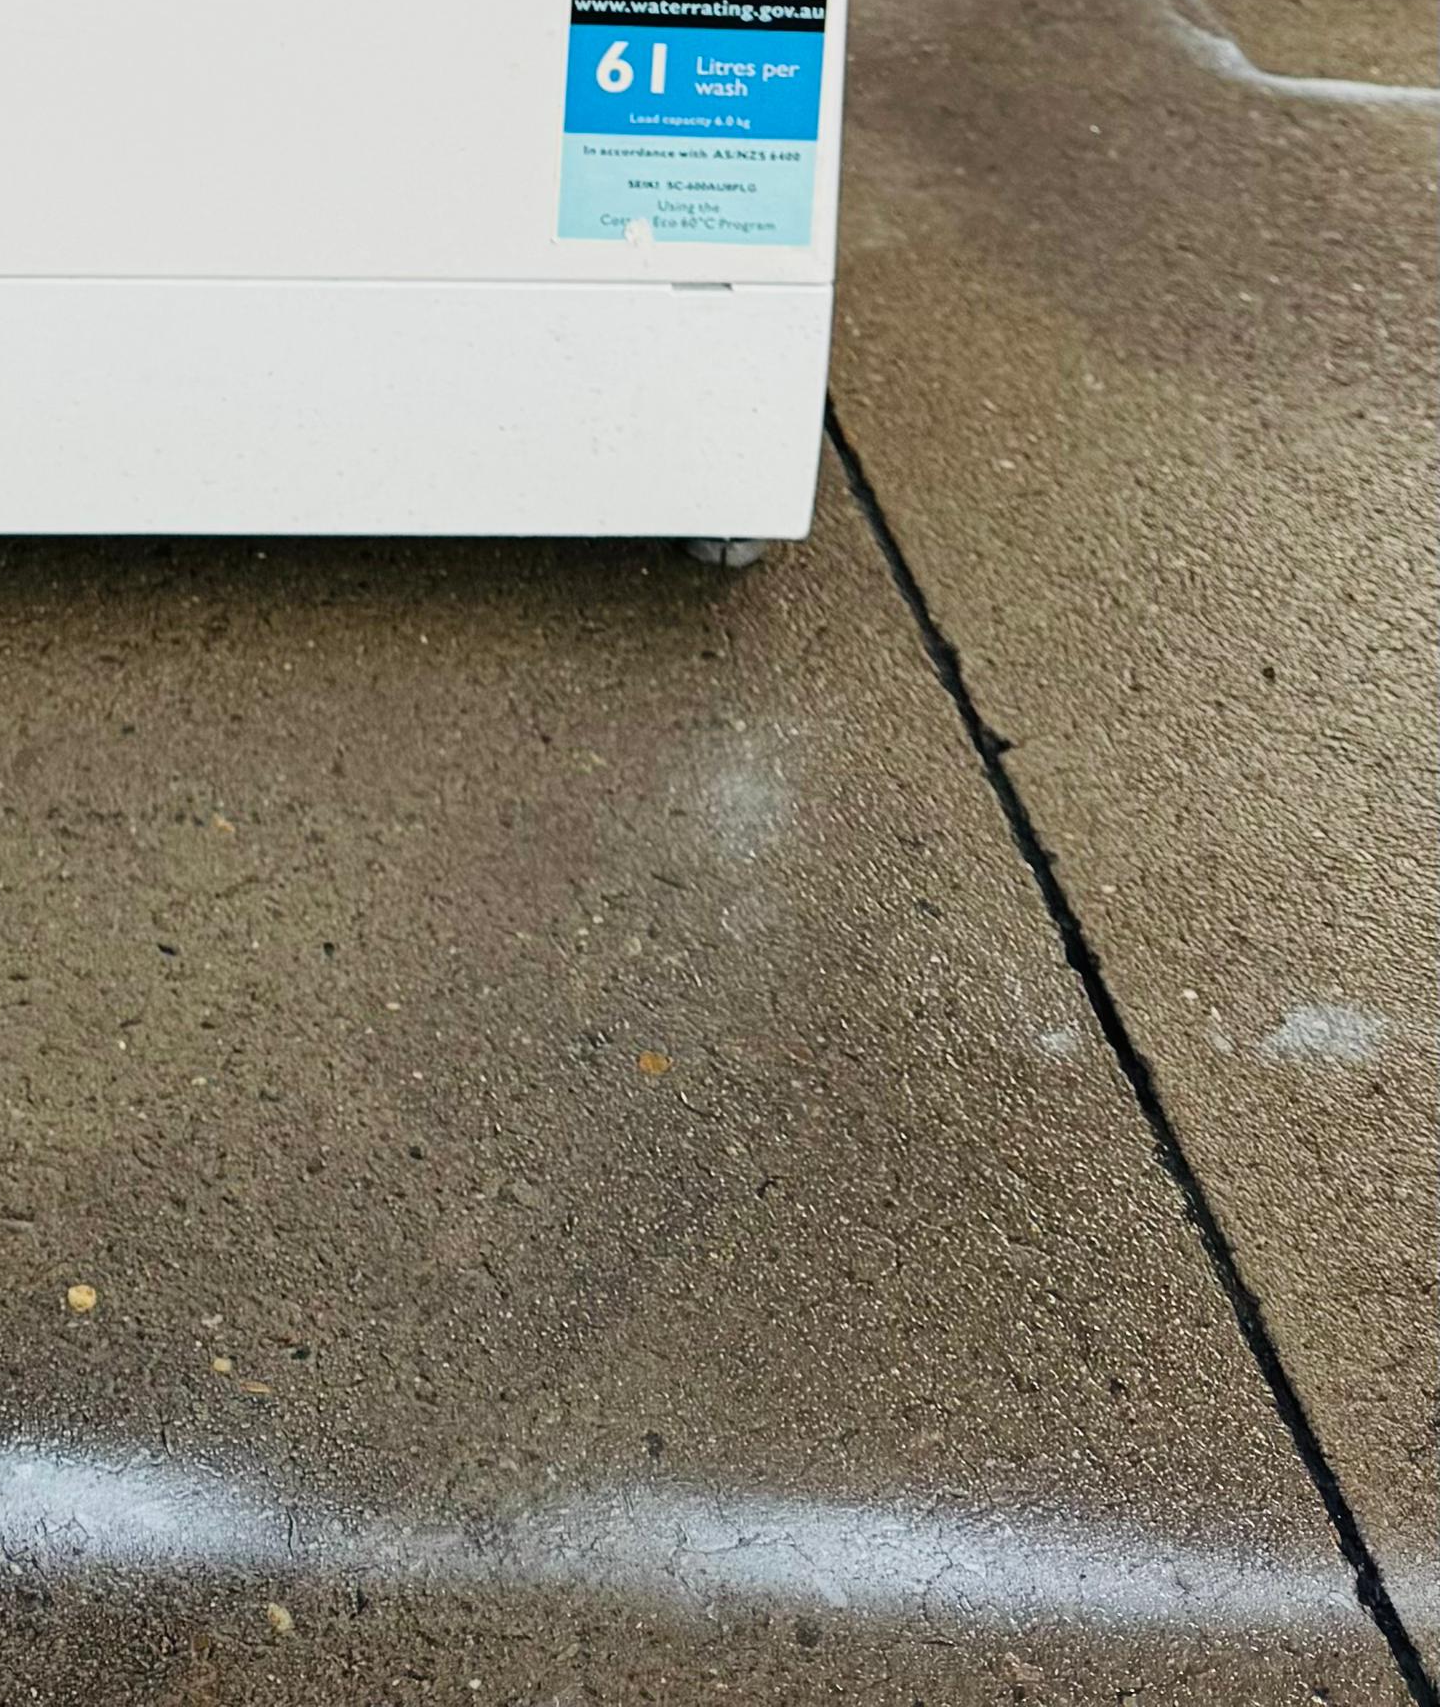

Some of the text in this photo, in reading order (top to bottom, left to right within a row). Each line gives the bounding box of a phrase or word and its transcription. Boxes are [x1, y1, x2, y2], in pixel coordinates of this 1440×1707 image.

[574, 0, 825, 22] www.waterrating.gov.au
[596, 41, 667, 94] 61
[696, 57, 800, 82] Litres per
[695, 79, 748, 96] wash
[630, 113, 659, 124] Load
[662, 115, 711, 127] capacity
[583, 145, 596, 156] In
[600, 147, 674, 158] accordance
[679, 149, 708, 159] with
[657, 200, 720, 214] Using the
[652, 216, 678, 229] Eco
[719, 218, 776, 233] Program
